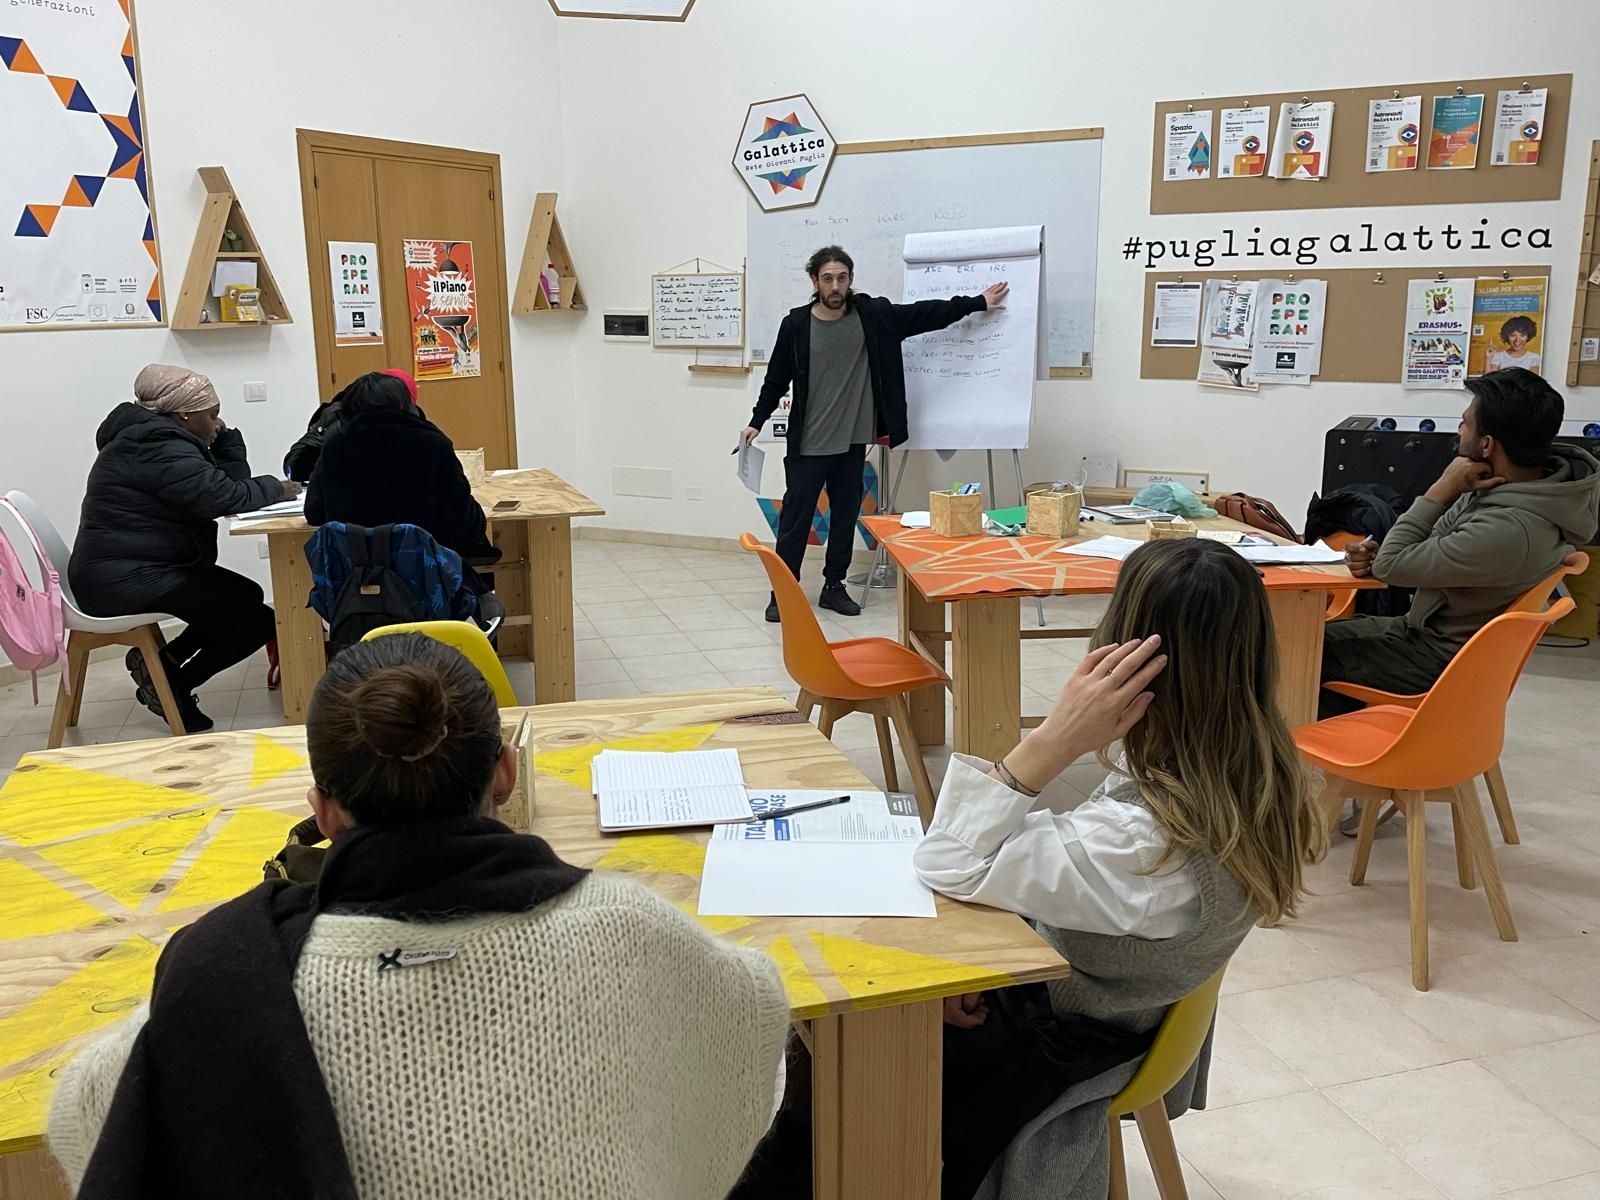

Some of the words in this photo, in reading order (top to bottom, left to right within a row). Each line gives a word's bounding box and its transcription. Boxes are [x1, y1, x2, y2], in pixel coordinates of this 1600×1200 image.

[1373, 110, 1403, 118] Astronauti
[1170, 124, 1193, 132] Spazio
[743, 138, 825, 162] Galattica
[745, 164, 763, 172] Rete
[766, 158, 796, 168] Giovani
[799, 152, 825, 163] Puglia
[1122, 218, 1552, 269] #pugliagalattica
[341, 254, 368, 266] PRO
[343, 269, 368, 281] SPE
[344, 283, 370, 295] RAN
[433, 281, 440, 293] il
[440, 281, 467, 293] Piano
[1272, 293, 1311, 305] PRO
[26, 308, 48, 320] FSC
[1271, 309, 1310, 321] SPE
[1269, 323, 1308, 335] RAN
[1418, 321, 1462, 329] ERASMUS+
[744, 797, 769, 840] ITALNO
